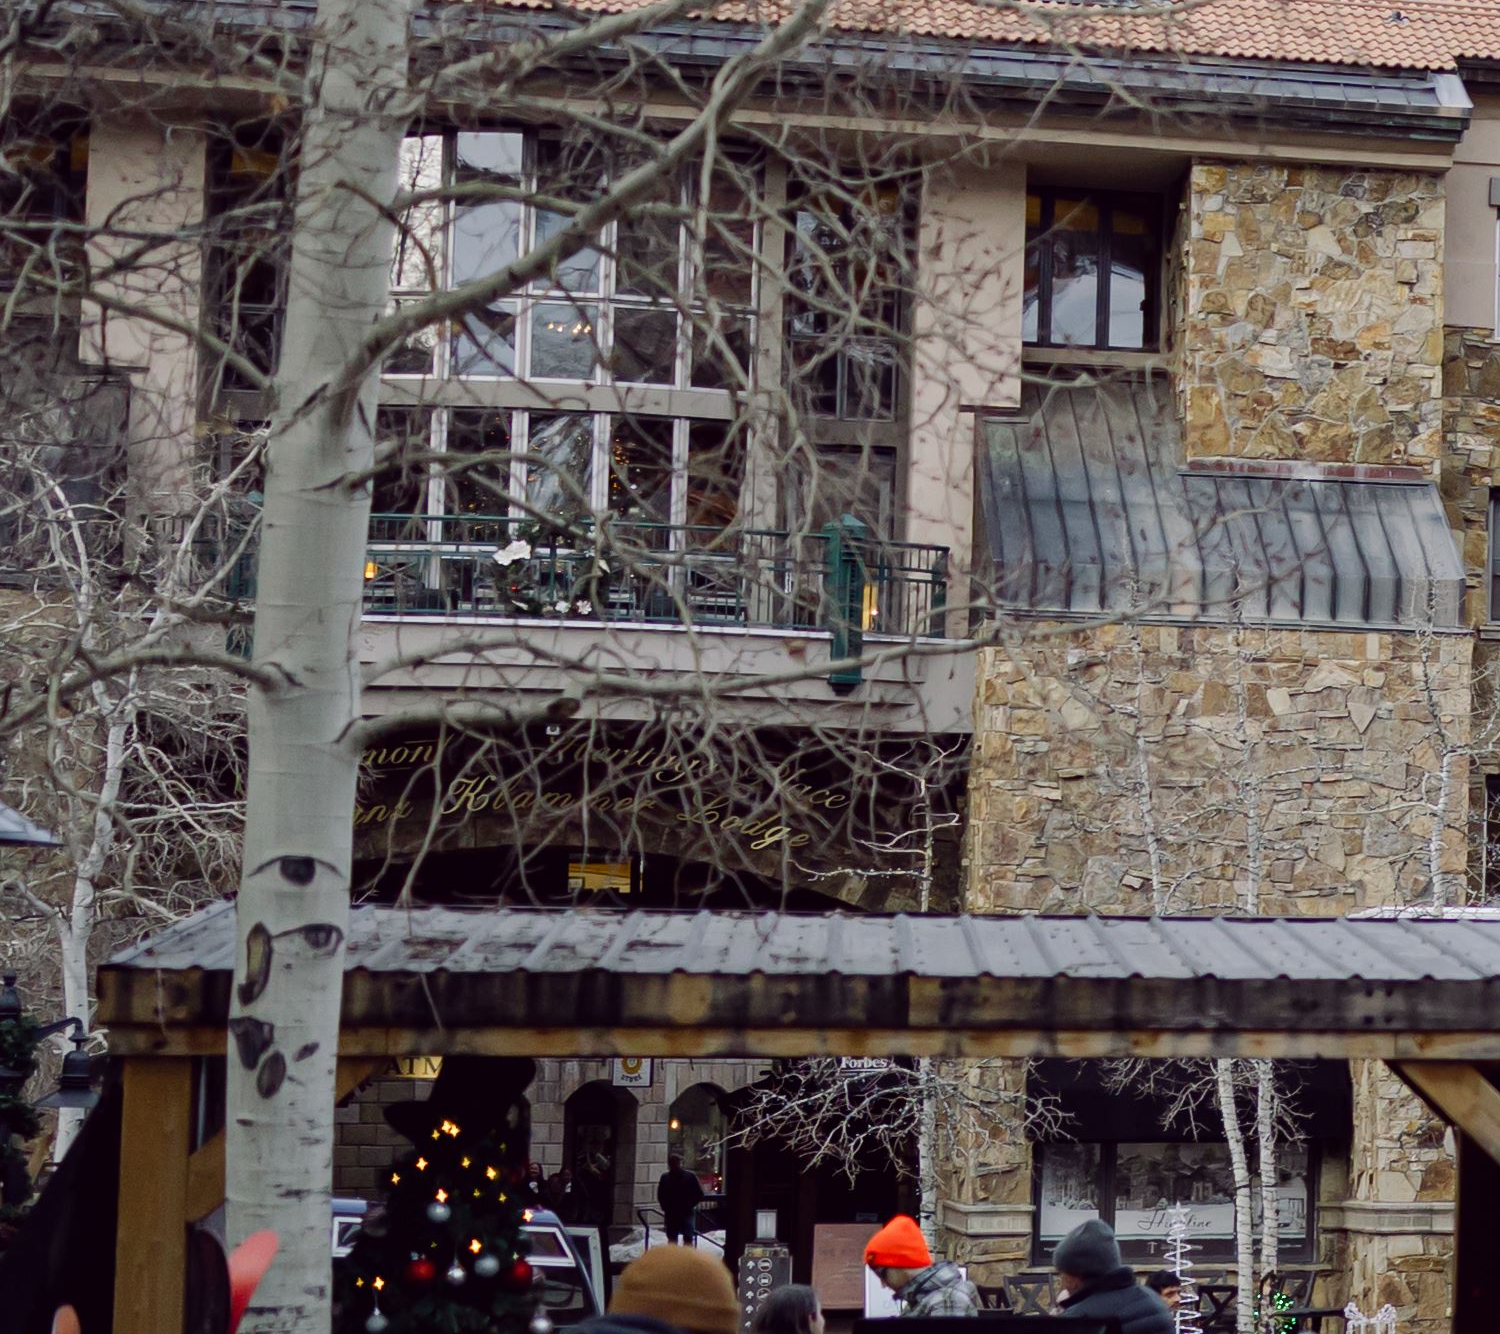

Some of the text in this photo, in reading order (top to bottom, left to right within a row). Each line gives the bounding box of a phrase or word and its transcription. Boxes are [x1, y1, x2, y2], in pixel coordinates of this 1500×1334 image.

[440, 774, 655, 815] Klammer
[677, 792, 810, 850] Lodge
[841, 1056, 888, 1068] Forbes
